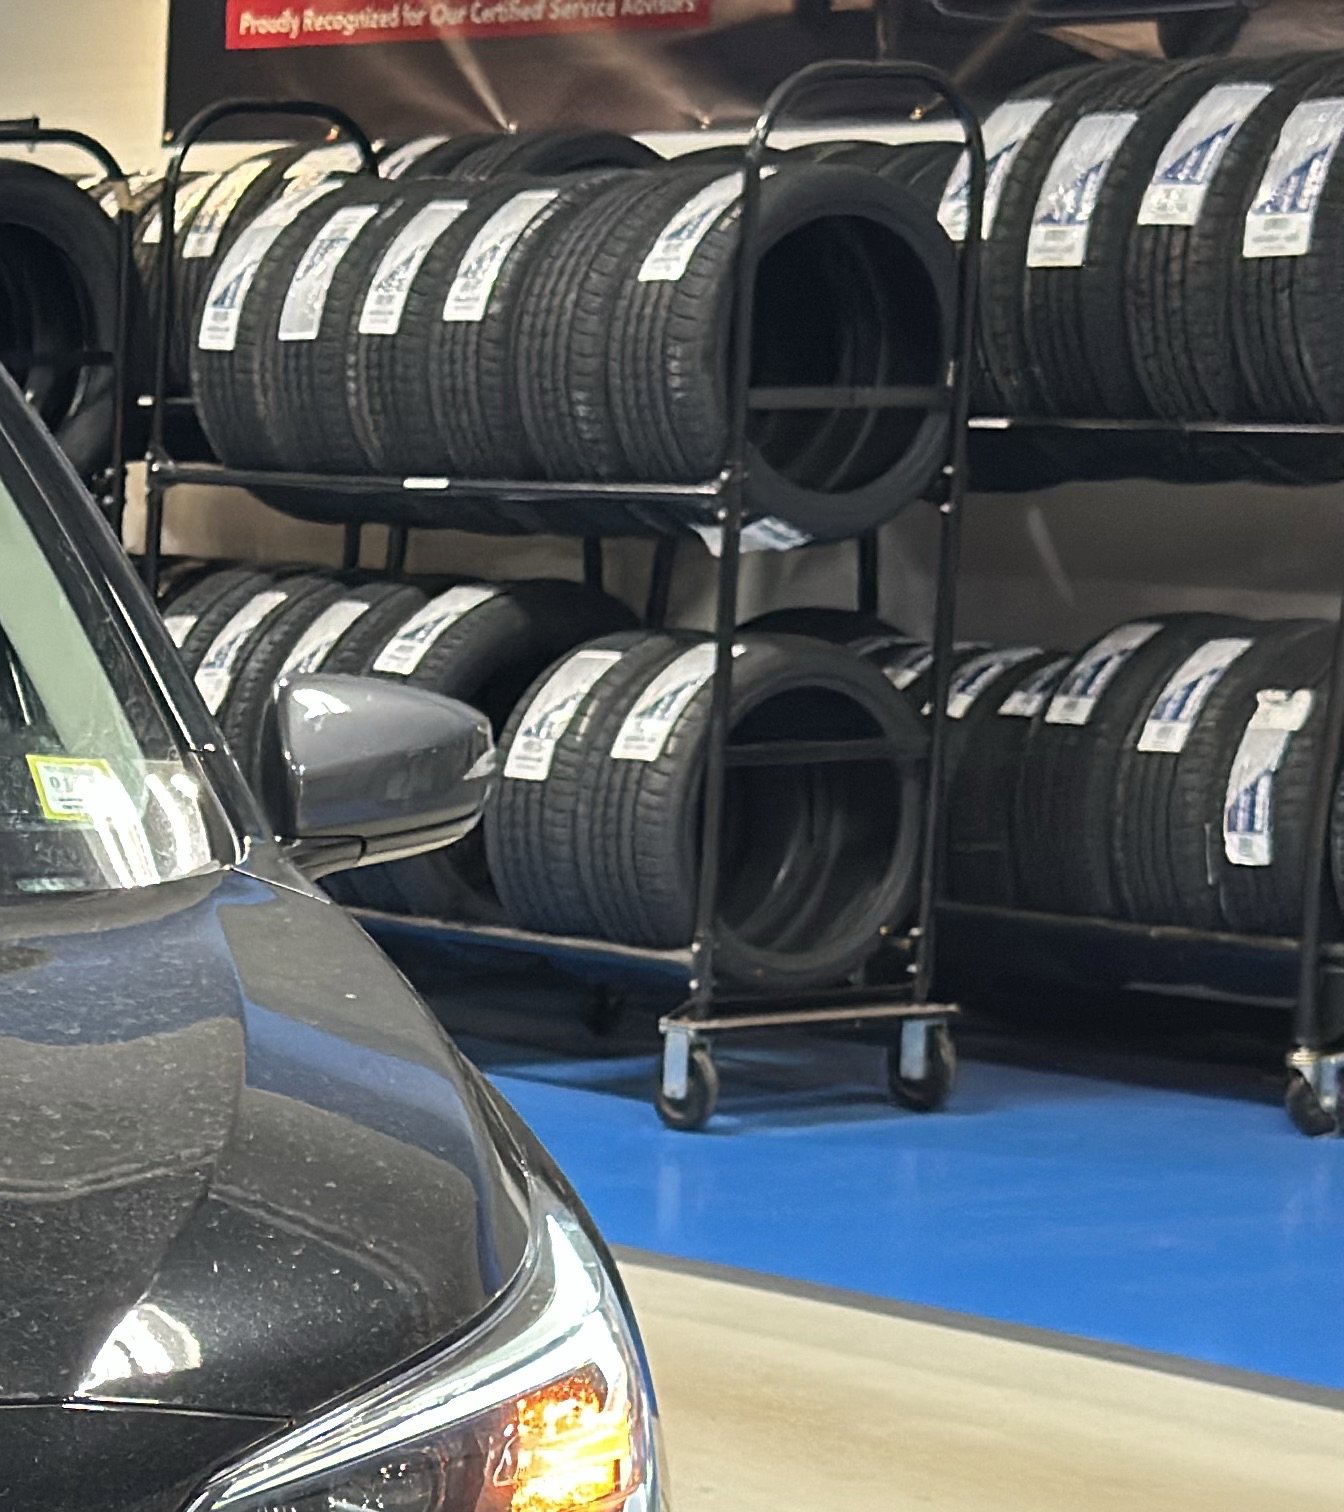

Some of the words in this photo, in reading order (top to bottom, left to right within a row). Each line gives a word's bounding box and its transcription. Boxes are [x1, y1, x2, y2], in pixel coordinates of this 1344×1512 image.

[239, 9, 300, 39] Proudly
[302, 7, 400, 36] Recognized
[402, 4, 427, 26] for
[429, 3, 466, 26] Our
[470, 1, 544, 24] Certified
[548, 0, 616, 20] Service
